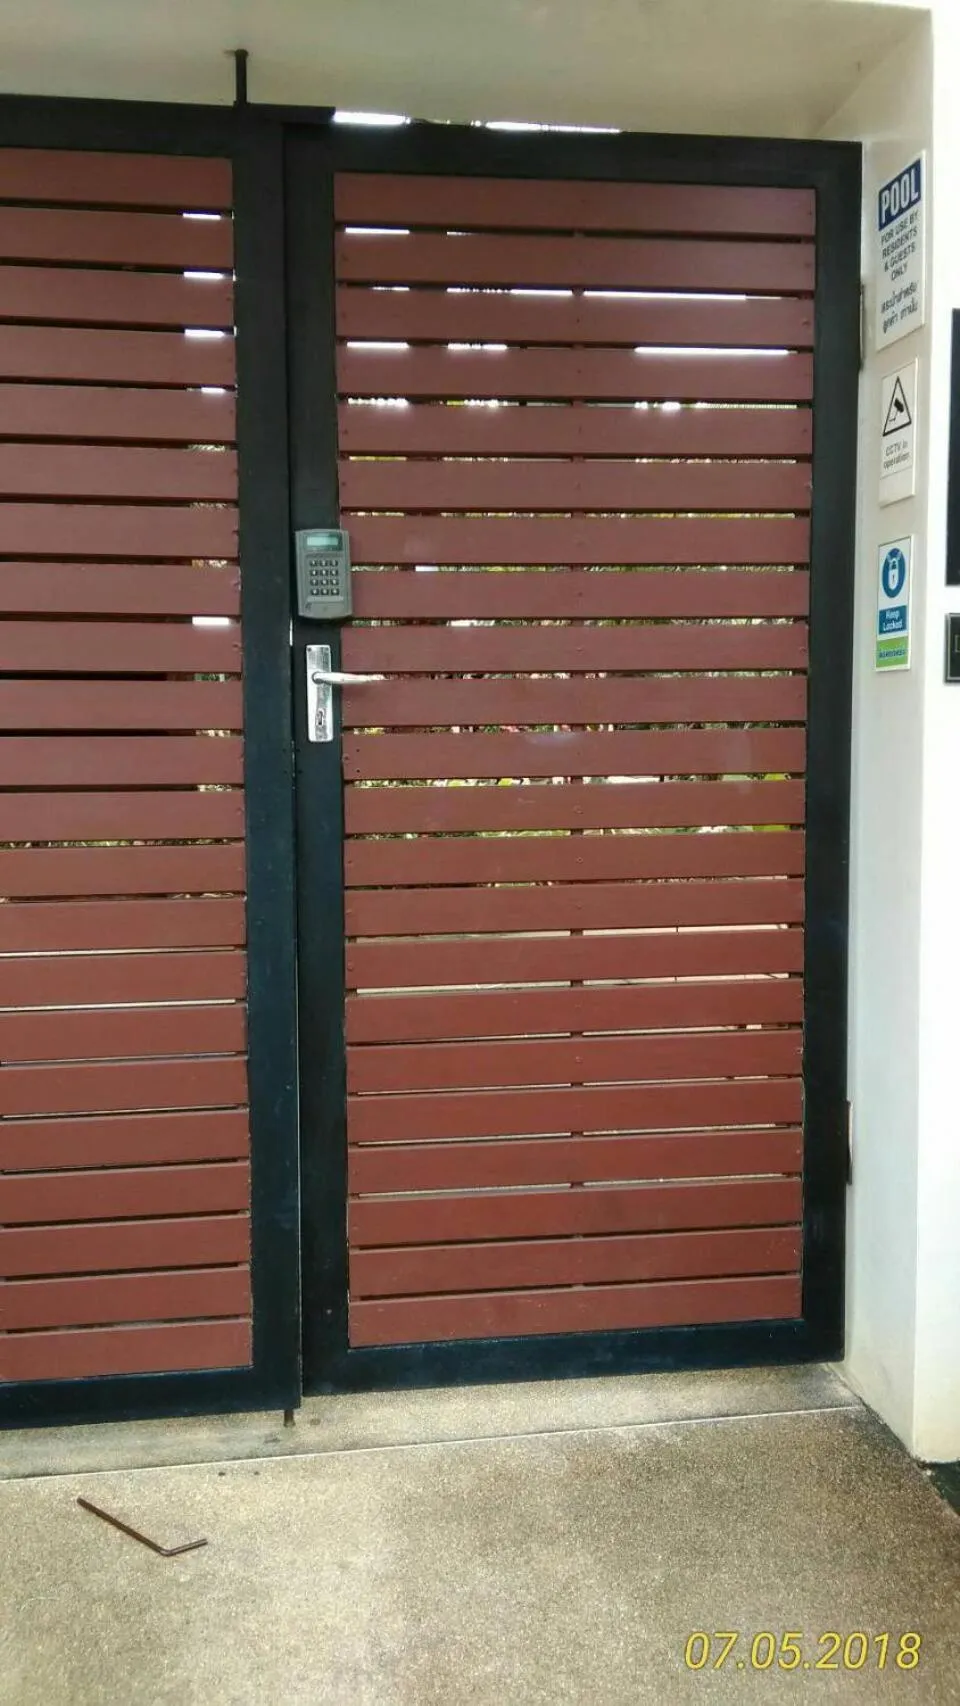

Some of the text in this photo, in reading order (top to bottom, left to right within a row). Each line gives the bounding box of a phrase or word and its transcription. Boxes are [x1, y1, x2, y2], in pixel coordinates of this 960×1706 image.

[881, 168, 919, 224] POOL
[881, 209, 919, 246] FOR USE BY
[882, 226, 917, 259] RESIDENTS
[890, 241, 915, 268] GUESTS
[891, 261, 907, 280] ONLY
[886, 441, 901, 456] CCTV
[883, 619, 903, 631] Locked
[886, 610, 900, 620] Keep
